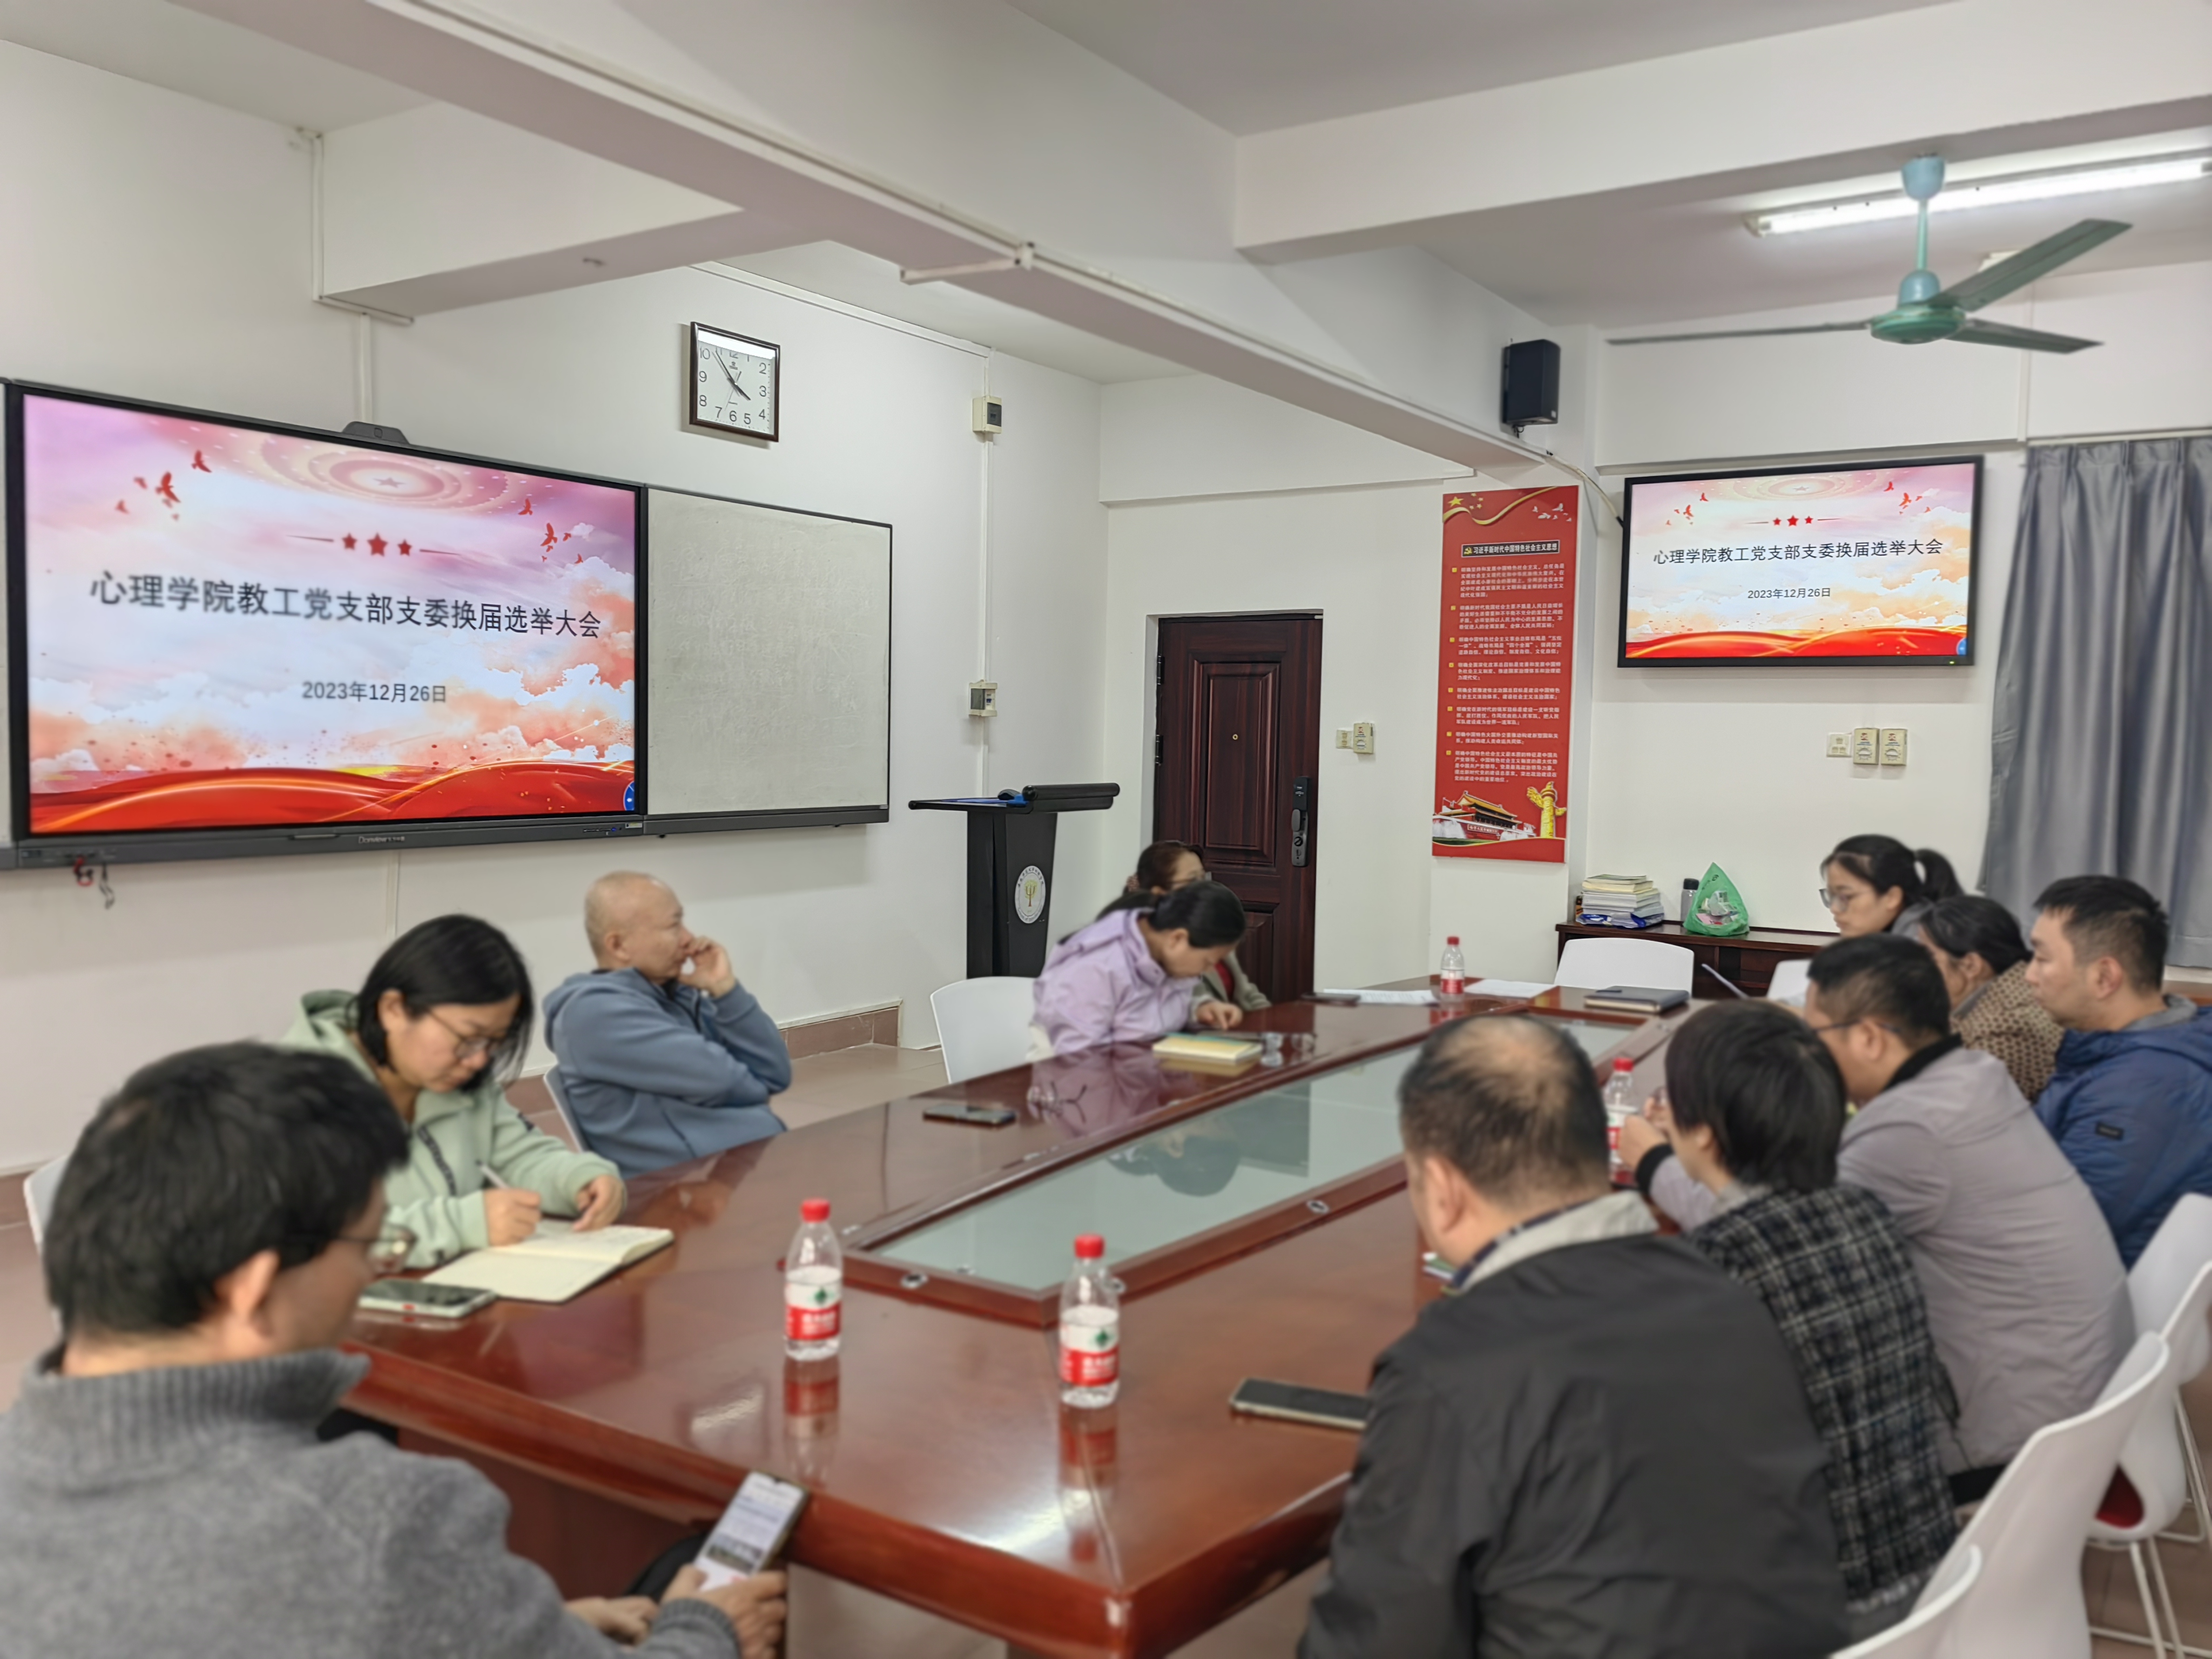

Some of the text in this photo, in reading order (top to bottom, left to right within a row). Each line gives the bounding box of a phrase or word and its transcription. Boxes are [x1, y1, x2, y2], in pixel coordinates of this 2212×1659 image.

[700, 346, 711, 360] 10
[759, 362, 767, 375] 2
[699, 370, 707, 382] 9
[759, 386, 767, 397] 3
[699, 395, 707, 407] 8
[714, 406, 723, 419] 7
[729, 410, 737, 422] 6
[743, 413, 751, 424] 5
[758, 409, 766, 420] 4
[1473, 543, 1557, 554] 习近平新时代中国特色社会主义思想
[1654, 538, 1943, 564] 心理学院教工党支部支委换届选举大会
[1748, 588, 1831, 599] 2023年12月26日
[90, 571, 601, 638] 心理学院教工党支部支委换届选举大会
[302, 681, 446, 703] 2023年12月26日
